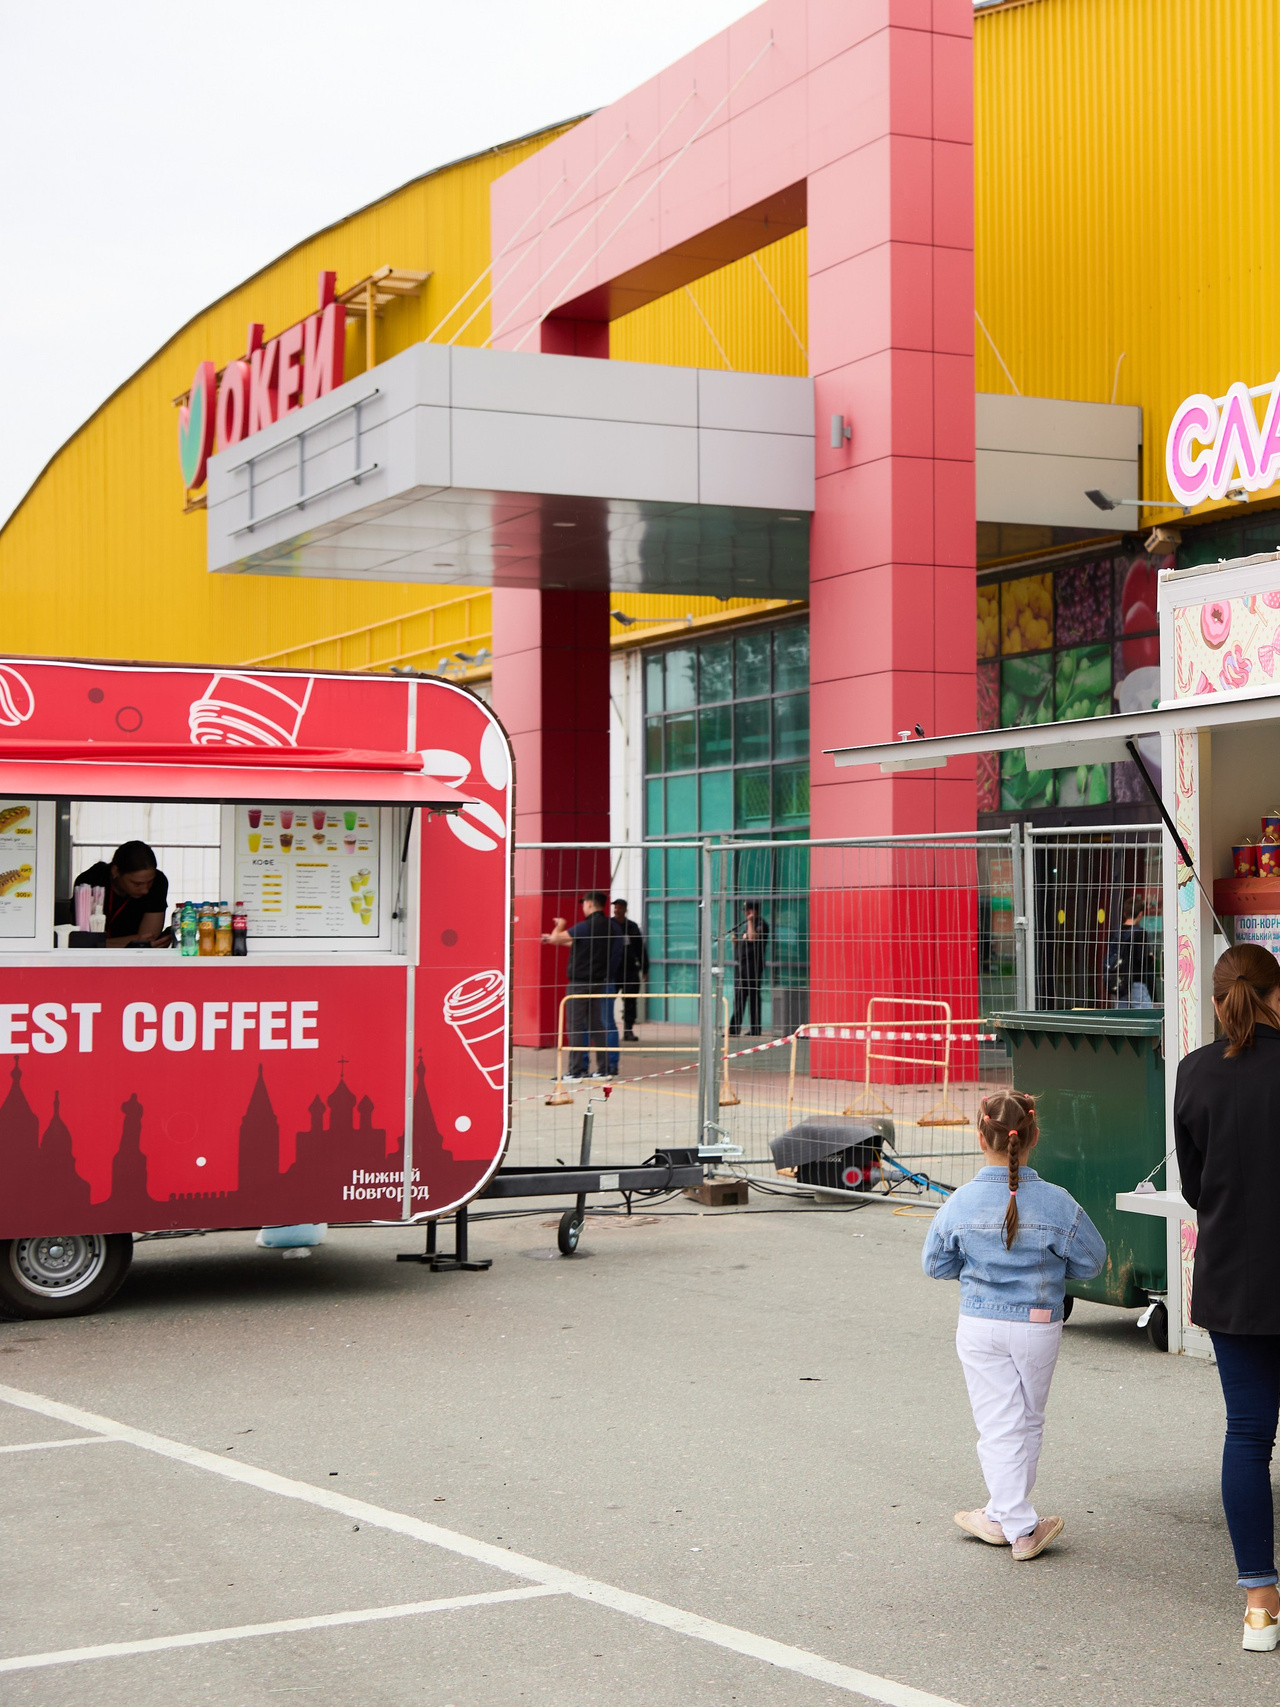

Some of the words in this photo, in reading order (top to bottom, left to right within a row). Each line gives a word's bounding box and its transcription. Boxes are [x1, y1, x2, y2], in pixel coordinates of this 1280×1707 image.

[1236, 931, 1272, 941] МАЛЕНЬКИЙ
[122, 1001, 319, 1052] COFFEE
[343, 1185, 430, 1203] Новгород
